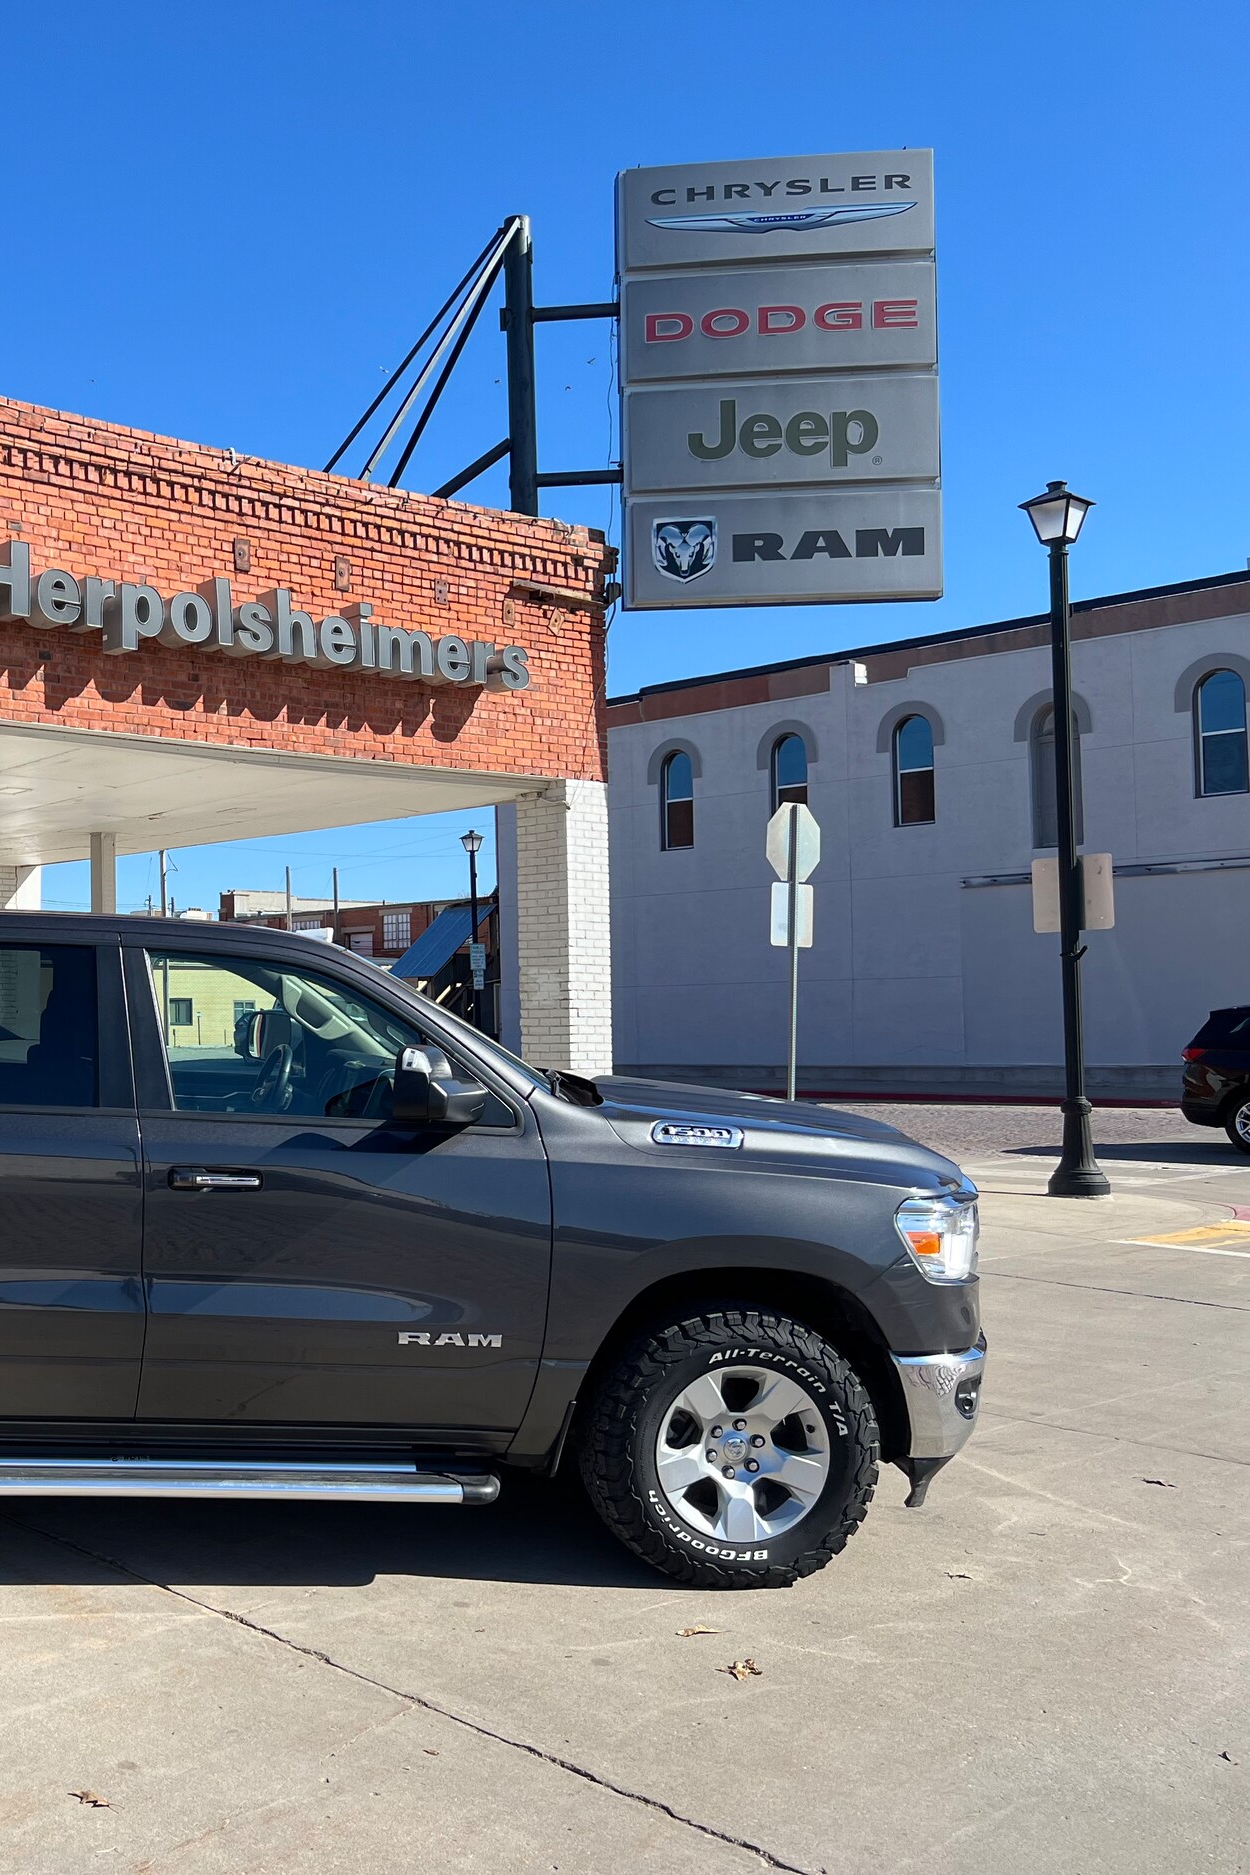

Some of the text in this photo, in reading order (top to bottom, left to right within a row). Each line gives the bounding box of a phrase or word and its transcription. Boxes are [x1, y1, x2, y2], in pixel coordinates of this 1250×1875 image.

[650, 173, 913, 206] CHRYSLER
[645, 299, 919, 344] DODGE
[687, 398, 880, 469] Jeep
[731, 526, 926, 563] RAM
[397, 1331, 502, 1348] RAM
[708, 1348, 849, 1437] All-Terrain T/A
[647, 1489, 769, 1562] BFGoodrich
